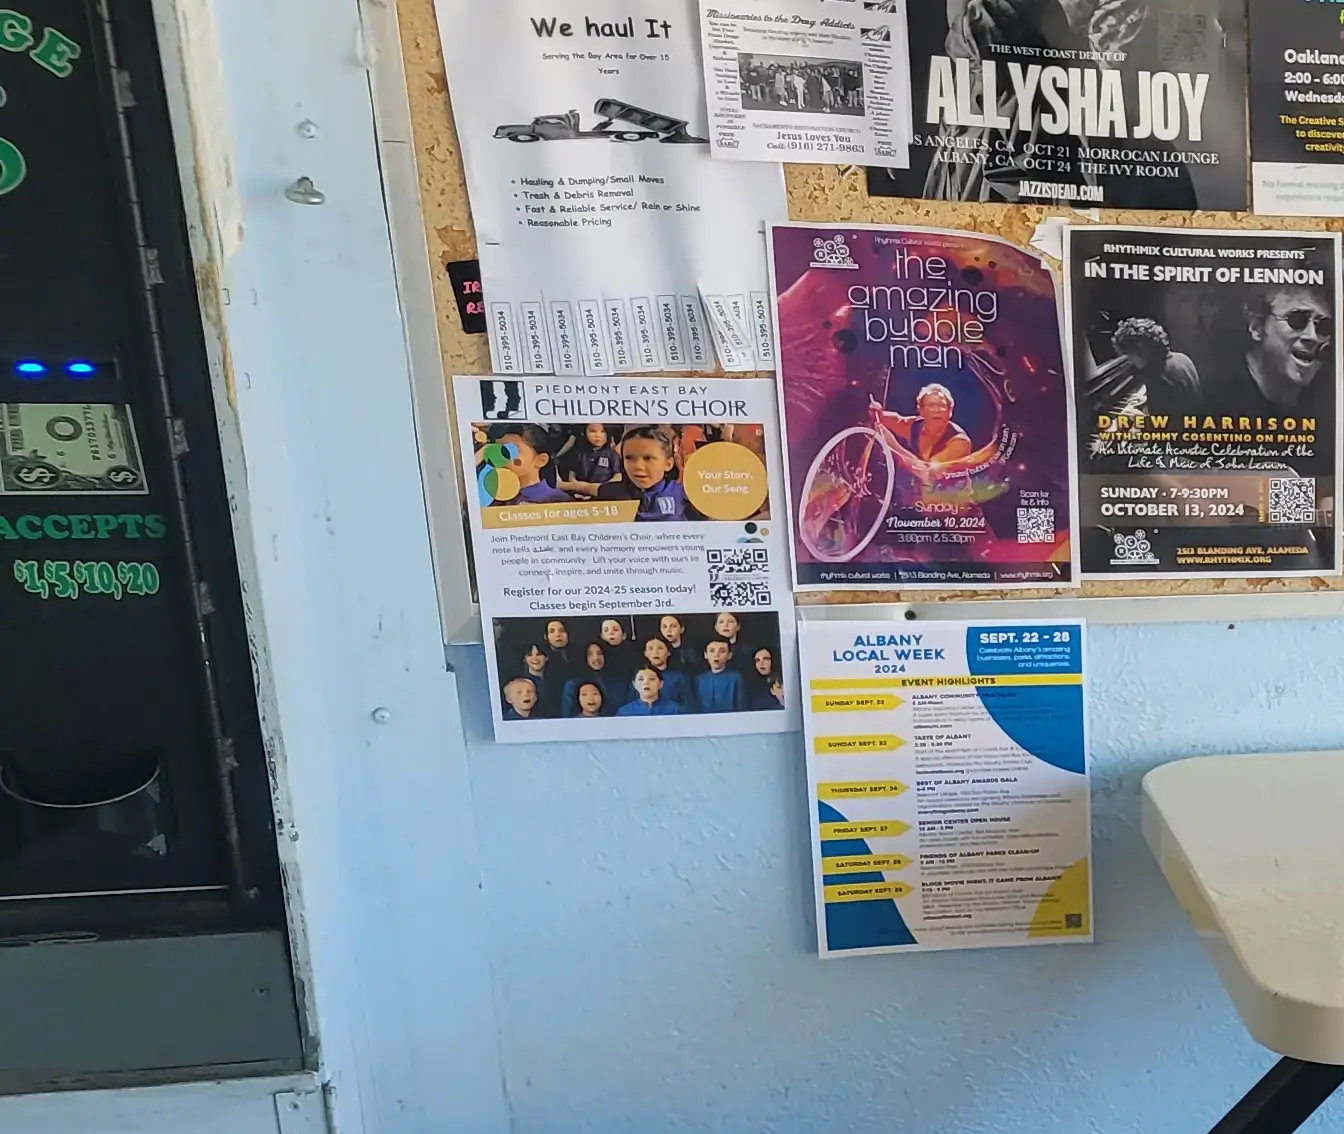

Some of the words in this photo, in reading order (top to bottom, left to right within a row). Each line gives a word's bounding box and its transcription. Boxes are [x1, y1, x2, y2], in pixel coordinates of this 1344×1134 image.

[532, 16, 573, 39] We
[584, 16, 635, 39] haul
[645, 18, 673, 39] It
[989, 43, 1012, 55] THE
[1013, 45, 1042, 57] WEST
[1043, 47, 1077, 59] COAST
[1079, 49, 1113, 62] DEBUT
[1114, 51, 1128, 62] OF
[926, 54, 1128, 139] ALLYSHA
[1133, 69, 1210, 142] JOY
[935, 150, 993, 167] ALBANY,
[995, 154, 1015, 166] CA
[1023, 157, 1055, 171] OCT
[1057, 160, 1071, 173] 24
[1079, 161, 1109, 175] THE
[1109, 163, 1133, 177] IVY
[1135, 164, 1180, 178] ROOM
[522, 189, 550, 200] Trash
[552, 190, 560, 200] &
[562, 189, 595, 200] Debris
[597, 188, 634, 199] Removal
[1018, 179, 1104, 202] JAZZISDEAD.COM
[896, 248, 947, 280] the
[1084, 262, 1107, 279] IN
[1110, 263, 1149, 281] THE
[1153, 266, 1213, 283] SPIRIT
[1215, 267, 1241, 283] OF
[1244, 269, 1324, 285] LENNON
[847, 281, 997, 323] amazing
[865, 310, 984, 343] bubble
[498, 309, 512, 370] 510-395-5034
[528, 310, 543, 369] 510-395-5034
[557, 309, 572, 368] 510-395-5034
[586, 309, 601, 367] 510-395-5034
[890, 345, 963, 369] man
[535, 385, 620, 396] PIEDMONT
[630, 386, 668, 396] EAST
[678, 386, 708, 395] BAY
[535, 399, 668, 417] CHILDREN'S
[676, 399, 748, 417] CHOIR
[1098, 414, 1170, 429] DREW
[1184, 416, 1317, 431] HARRISON
[697, 470, 721, 481] Your
[724, 471, 753, 481] Story,
[702, 484, 721, 493] Our
[724, 484, 748, 495] Song
[1100, 487, 1159, 499] SUNDAY
[1170, 487, 1229, 499] 7-9:30PM
[499, 510, 542, 522] Classes
[544, 508, 560, 518] for
[563, 508, 589, 519] ages
[592, 505, 618, 517] 5-18
[1101, 503, 1178, 517] OCTOBER
[1184, 503, 1205, 518] 13,
[1208, 504, 1245, 517] 2024
[0, 514, 167, 539] ACCEPTS
[886, 516, 943, 529] November
[943, 516, 959, 530] 10,
[960, 516, 986, 529] 2024
[530, 600, 567, 611] Classes
[569, 599, 596, 612] begin
[599, 598, 653, 611] September
[655, 598, 675, 609] 3rd.
[854, 634, 923, 648] ALBANY
[979, 632, 1019, 644] SEPT.
[1022, 632, 1040, 644] 22
[1053, 631, 1071, 643] 28
[833, 649, 891, 662] LOCAL
[894, 648, 945, 661] WEEK
[874, 664, 906, 675] 2024
[901, 678, 934, 687] EVENT
[937, 676, 996, 686] HIGHLIGHTS
